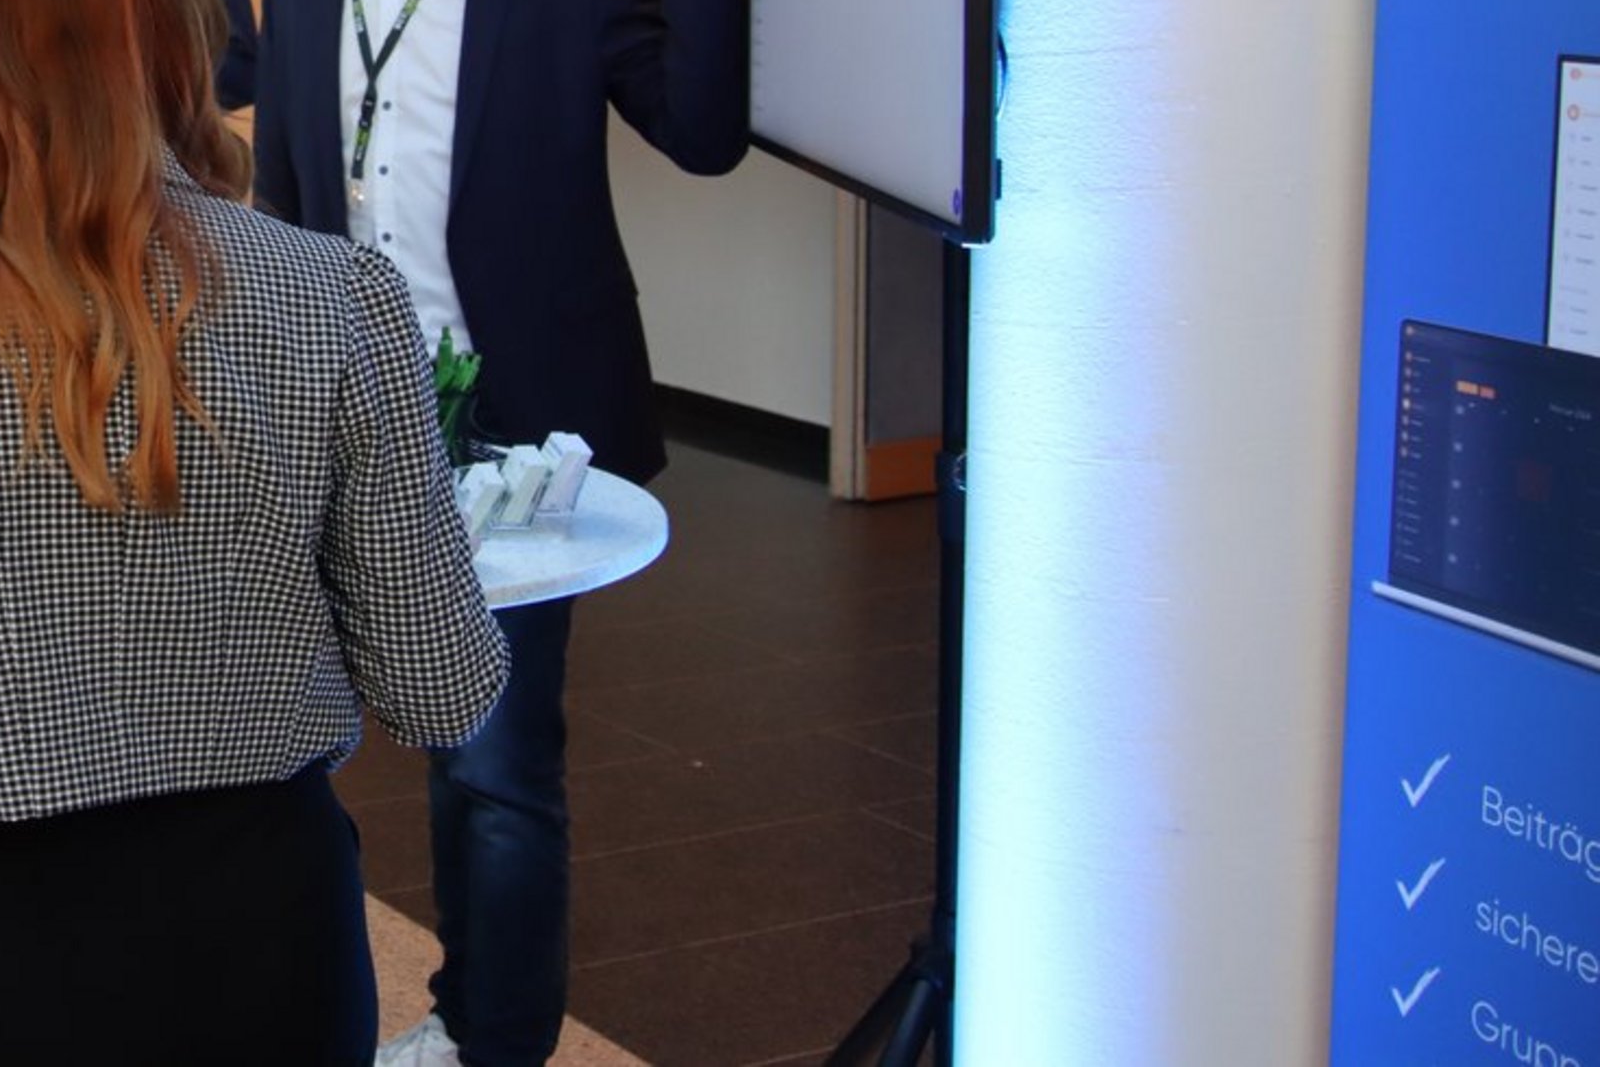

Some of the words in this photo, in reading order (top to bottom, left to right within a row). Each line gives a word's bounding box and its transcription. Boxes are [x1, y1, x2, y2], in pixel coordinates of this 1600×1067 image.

[1482, 785, 1600, 883] Beiträg
[1475, 898, 1599, 983] sichere
[1471, 1000, 1580, 1067] Grup
